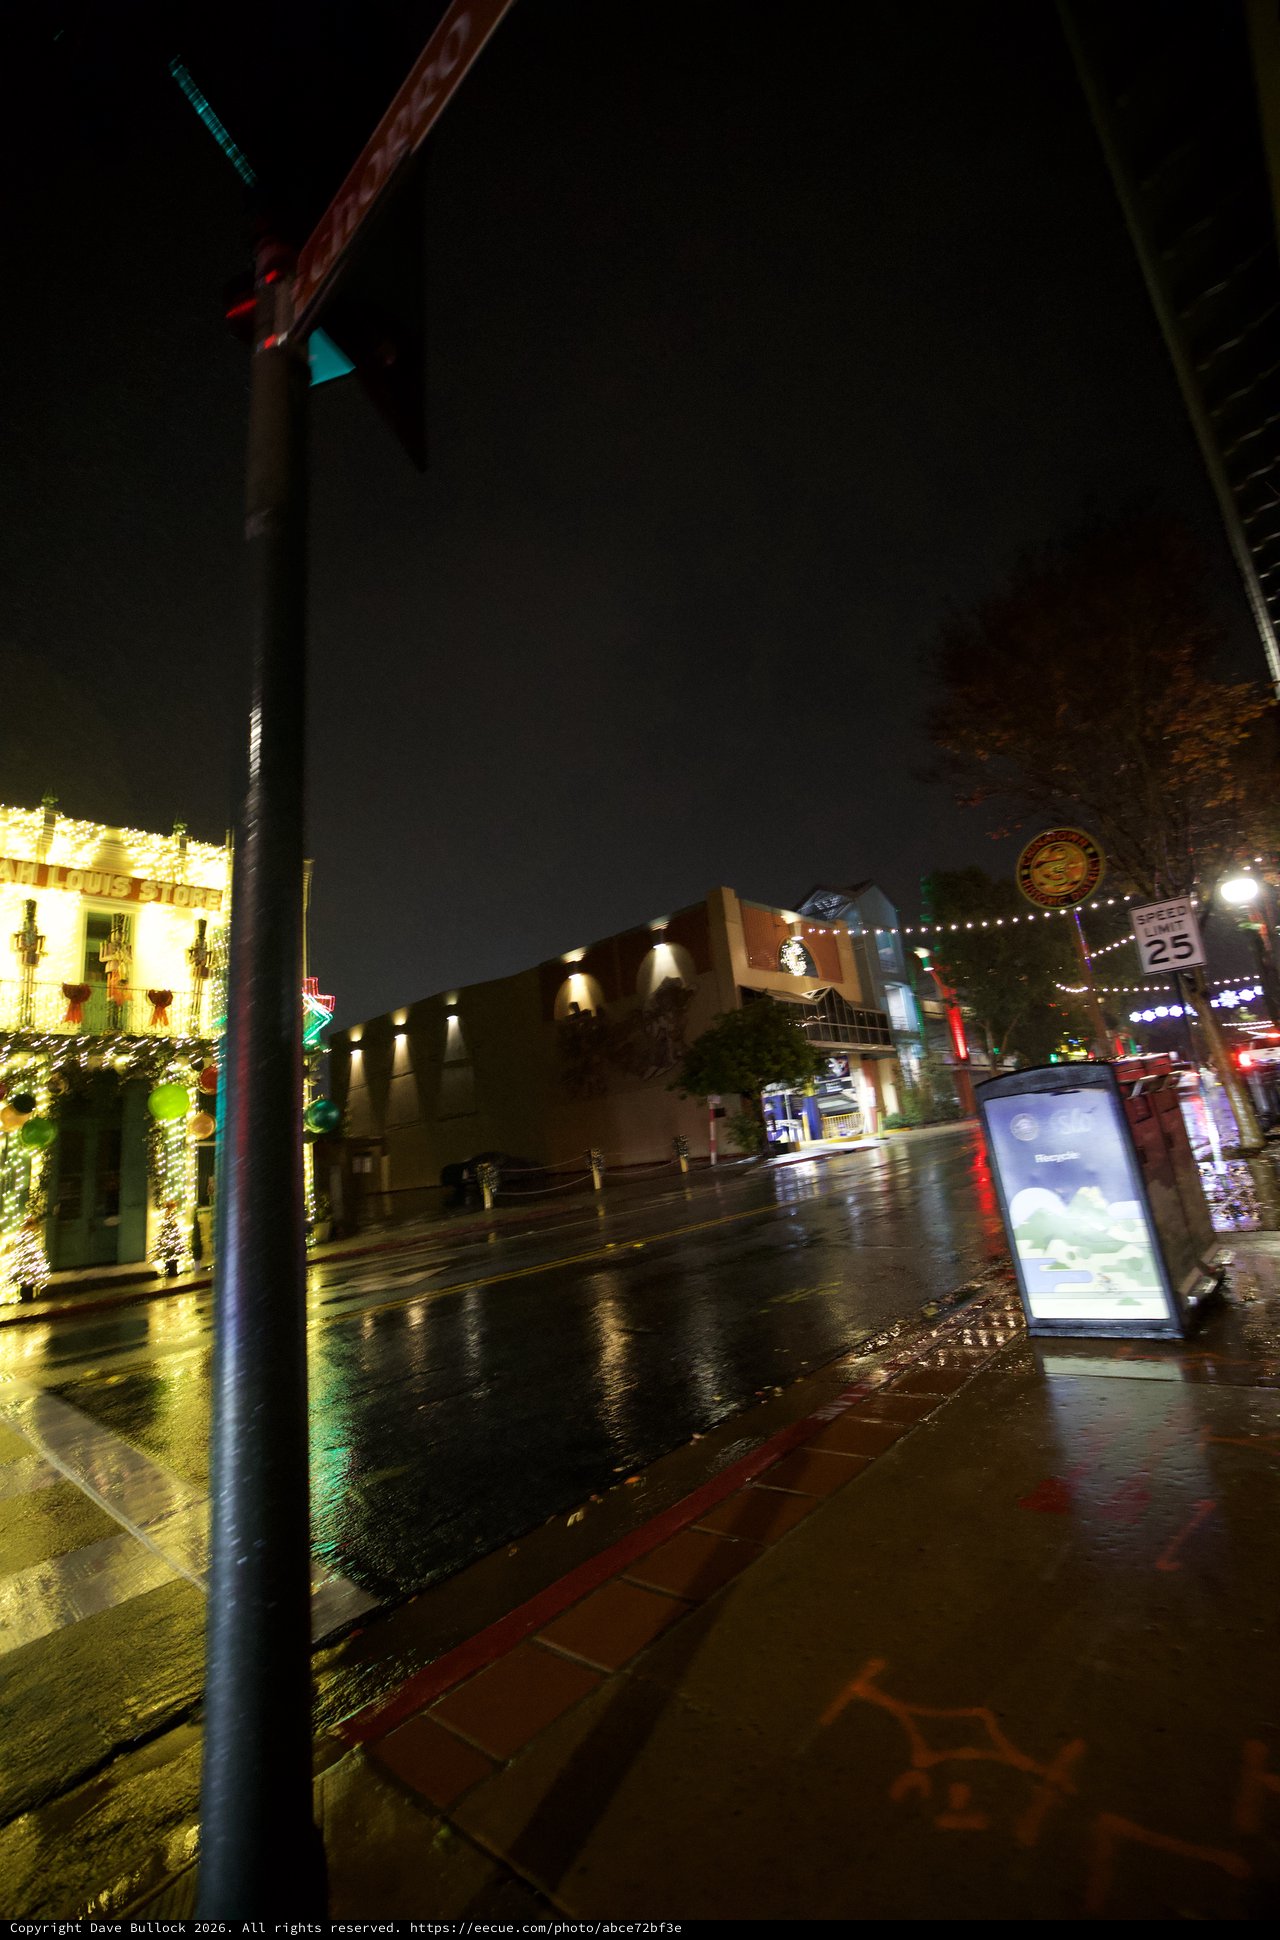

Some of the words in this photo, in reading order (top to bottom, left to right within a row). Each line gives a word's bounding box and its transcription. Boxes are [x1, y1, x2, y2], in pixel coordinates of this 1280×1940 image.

[0, 858, 38, 884] AH
[47, 864, 132, 900] LOUIS
[139, 879, 223, 911] STORE
[1136, 905, 1188, 926] SPEED
[1143, 920, 1186, 938] LIMIT
[1145, 933, 1195, 966] 25
[1034, 1150, 1081, 1163] Recycle
